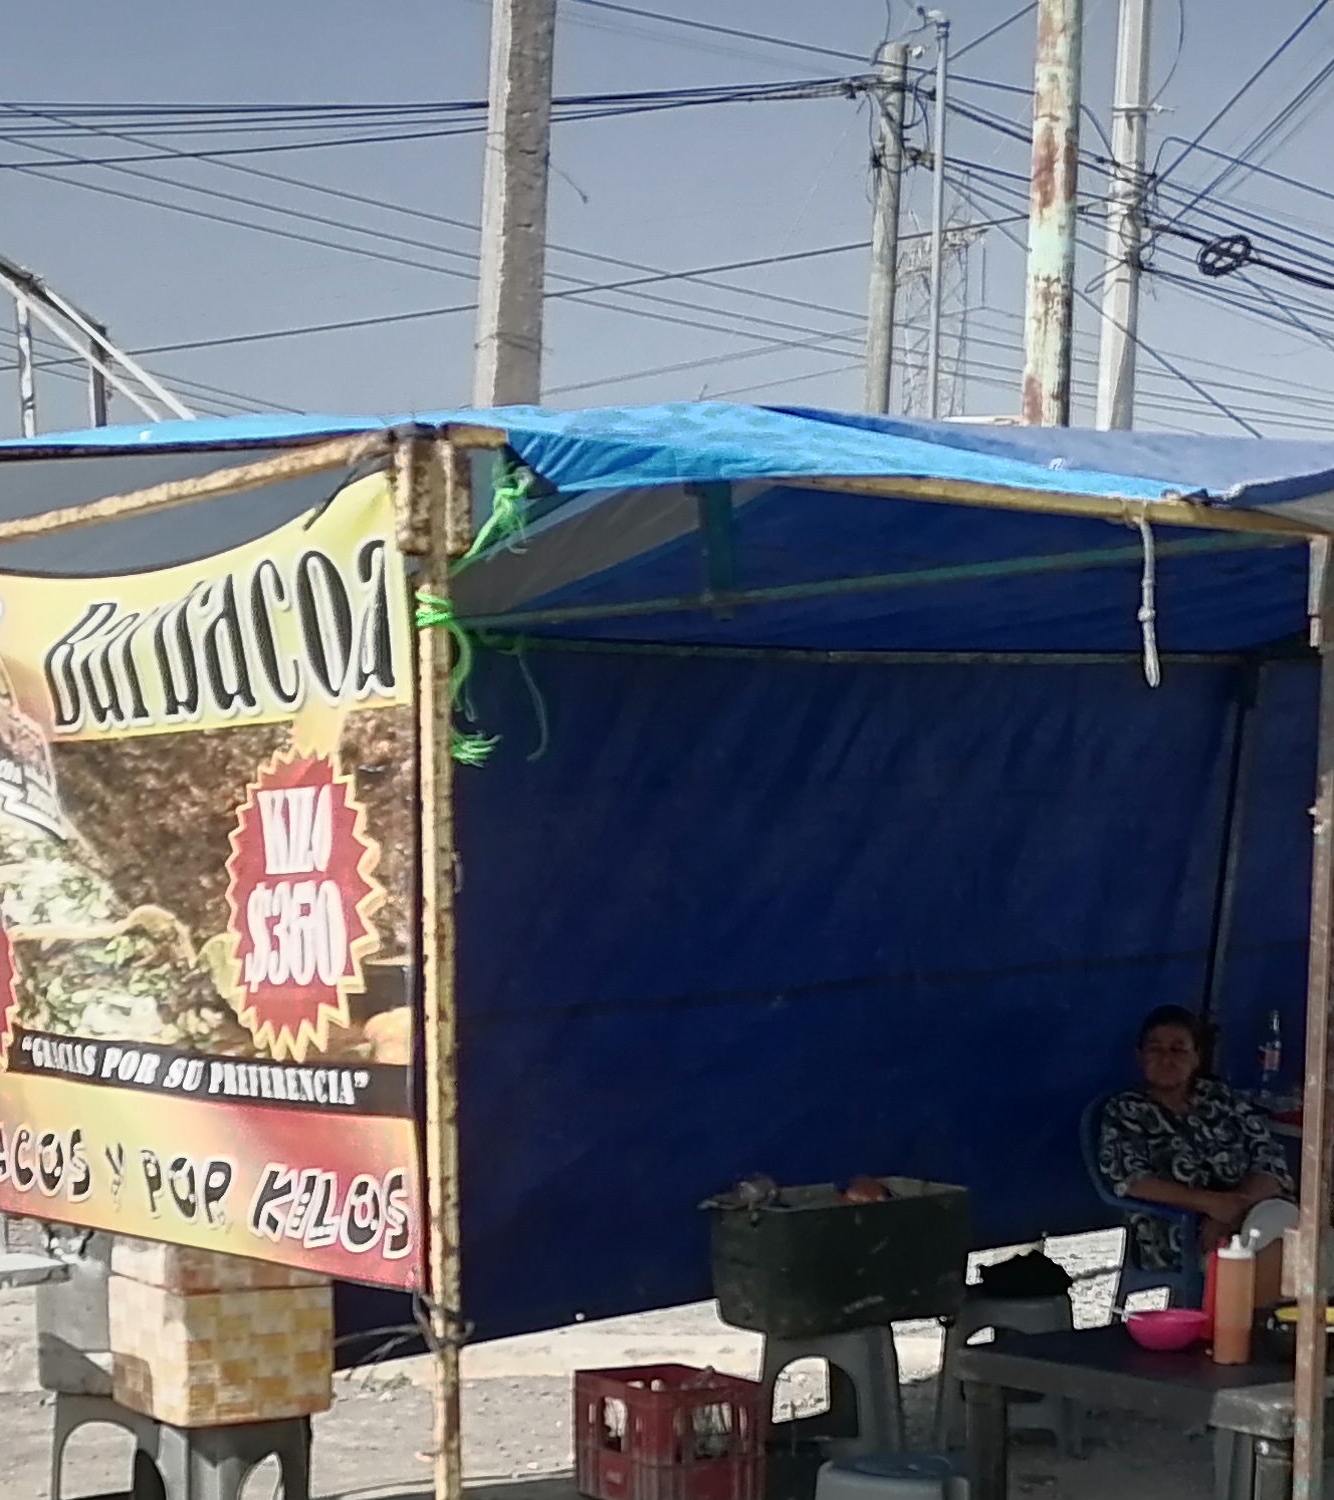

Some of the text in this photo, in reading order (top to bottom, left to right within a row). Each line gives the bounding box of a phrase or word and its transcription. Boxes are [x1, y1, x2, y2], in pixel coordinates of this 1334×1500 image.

[256, 783, 333, 875] KILO
[100, 1046, 162, 1085] POR
[162, 1057, 207, 1092] SU
[105, 1141, 125, 1212] Y
[139, 1148, 236, 1232] POR
[247, 1162, 414, 1260] KILOS
